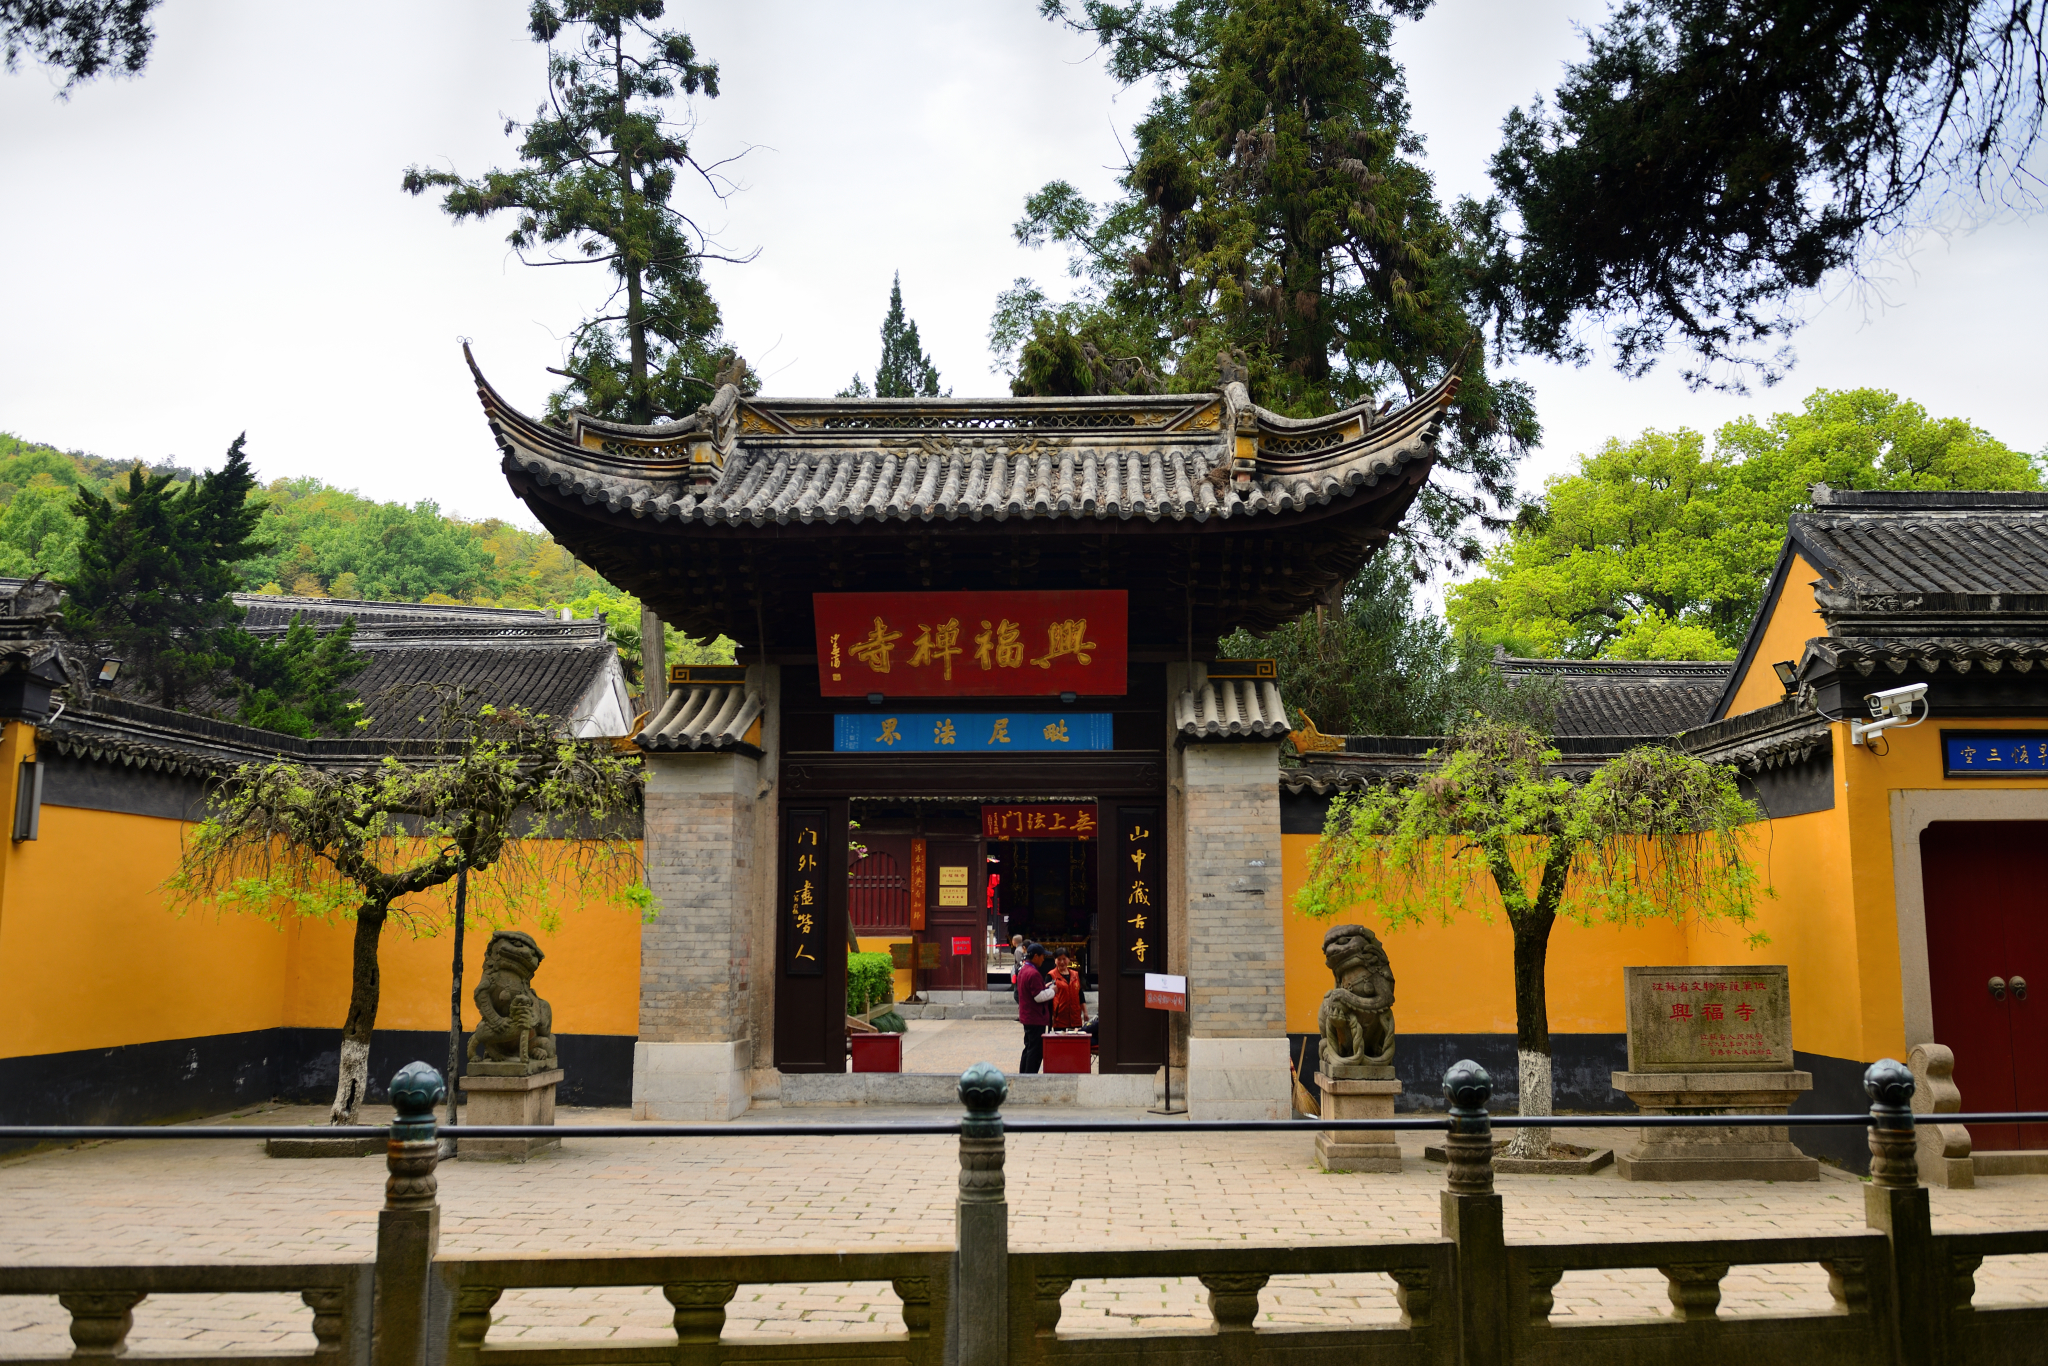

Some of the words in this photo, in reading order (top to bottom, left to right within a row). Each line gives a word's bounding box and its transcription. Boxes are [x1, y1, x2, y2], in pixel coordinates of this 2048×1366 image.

[1127, 825, 1151, 963] 山中藏古寺
[1669, 1002, 1756, 1023] 興福寺
